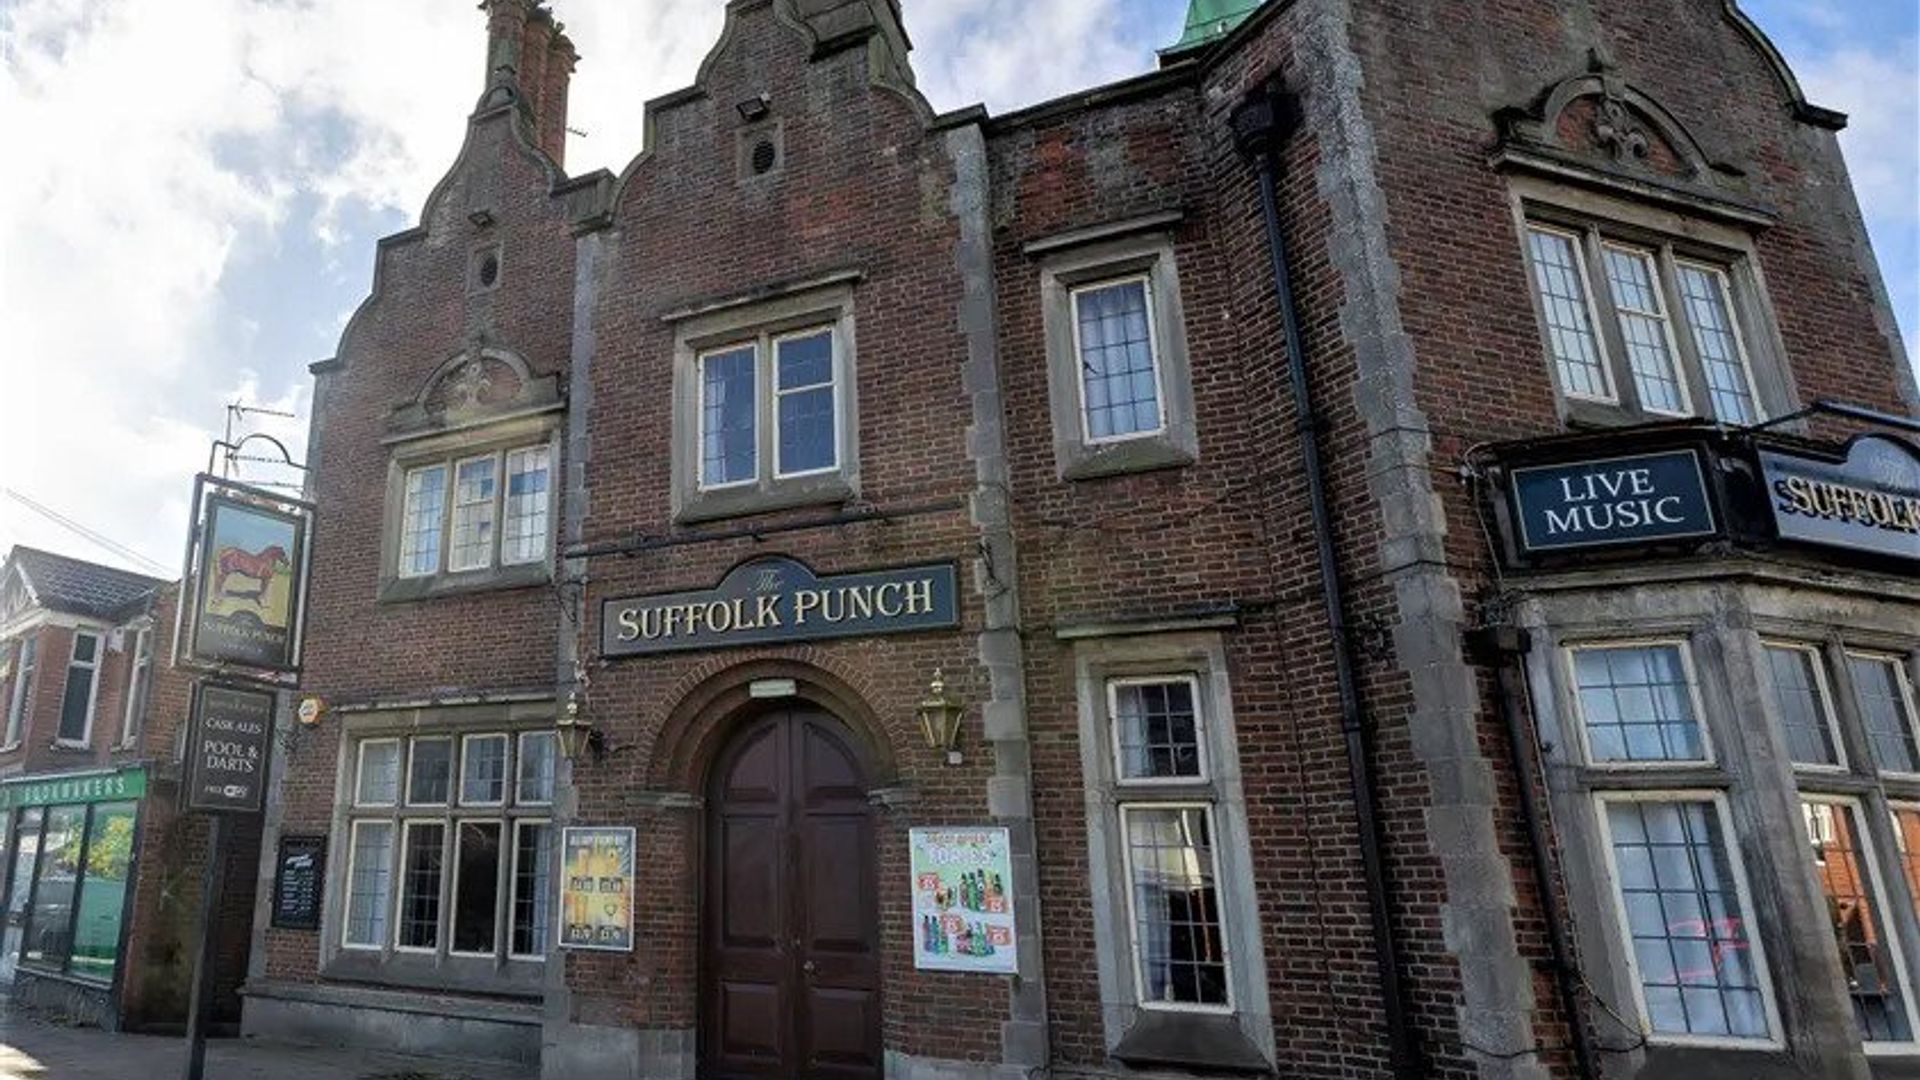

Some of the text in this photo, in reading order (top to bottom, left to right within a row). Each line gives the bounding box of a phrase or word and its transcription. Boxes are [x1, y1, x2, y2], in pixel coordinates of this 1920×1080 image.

[1559, 468, 1655, 502] LIVE
[1543, 496, 1686, 535] MUSIC
[746, 568, 785, 592] The
[616, 578, 934, 642] SUFFOLK PUNCH
[204, 716, 262, 735] CASK ALES
[203, 740, 259, 759] POOL &
[206, 755, 255, 773] DARTS
